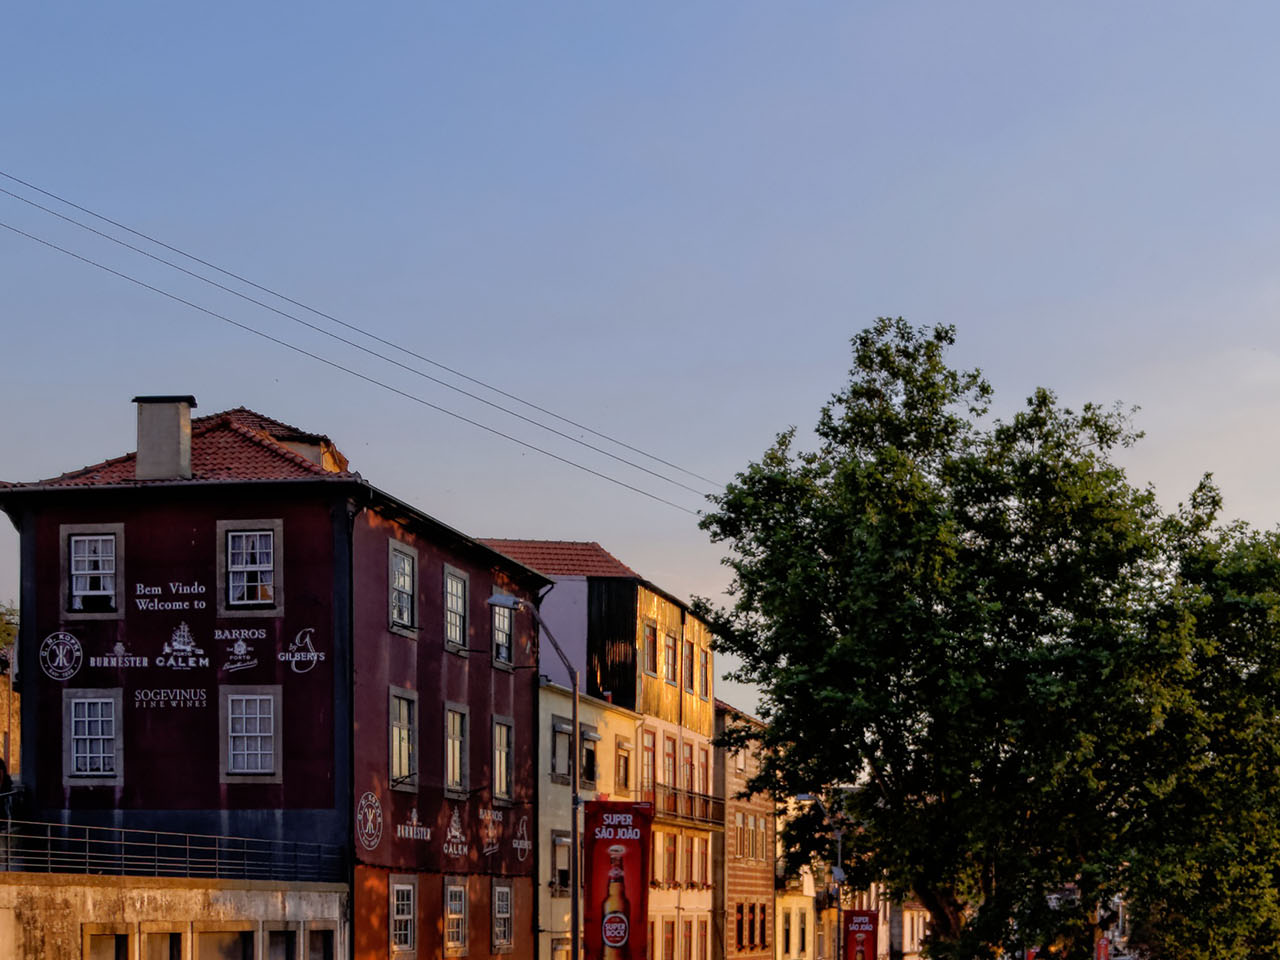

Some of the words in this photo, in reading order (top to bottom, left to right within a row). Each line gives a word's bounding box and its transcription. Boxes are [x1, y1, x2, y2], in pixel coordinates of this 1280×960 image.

[136, 583, 162, 595] Bem
[169, 581, 206, 594] Vindo
[135, 598, 190, 610] Welcome
[194, 600, 206, 609] to
[214, 629, 266, 639] BARROS
[89, 656, 148, 667] BURMESTER
[135, 689, 207, 701] SOGEVINUS
[170, 700, 207, 708] WINES
[603, 813, 633, 825] SUPER
[594, 825, 615, 839] SÃO
[616, 826, 640, 839] JOÃO
